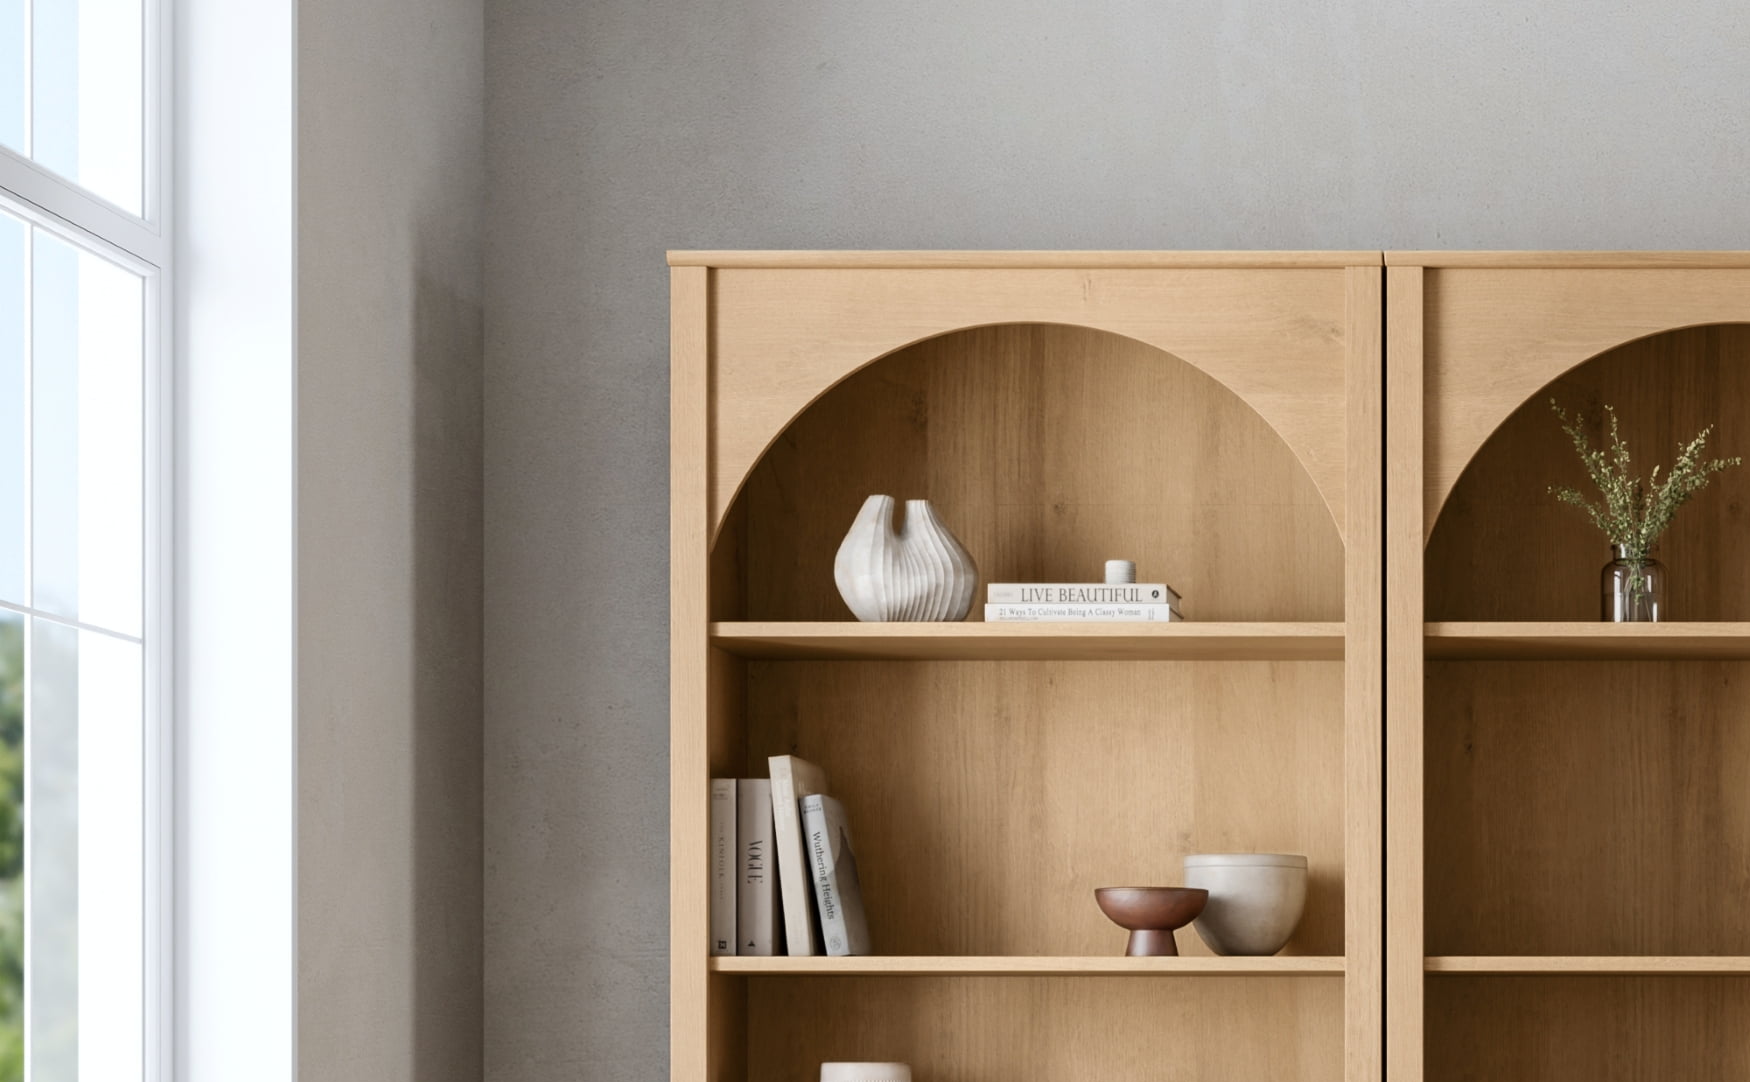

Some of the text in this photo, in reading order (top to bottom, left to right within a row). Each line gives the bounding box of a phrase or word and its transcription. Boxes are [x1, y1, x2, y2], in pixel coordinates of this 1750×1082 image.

[1021, 588, 1143, 602] LIVE BEAUTIFUL
[1000, 608, 1006, 616] 21
[1008, 608, 1026, 618] Ways
[1028, 608, 1036, 616] To
[1038, 608, 1066, 616] Cultivate
[1068, 608, 1086, 618] Being
[1088, 608, 1094, 616] A
[1095, 608, 1116, 618] Classy
[1118, 608, 1141, 616] Woman
[748, 840, 763, 884] VOGUE
[812, 831, 828, 882] Wuthering
[822, 883, 834, 920] Heights
